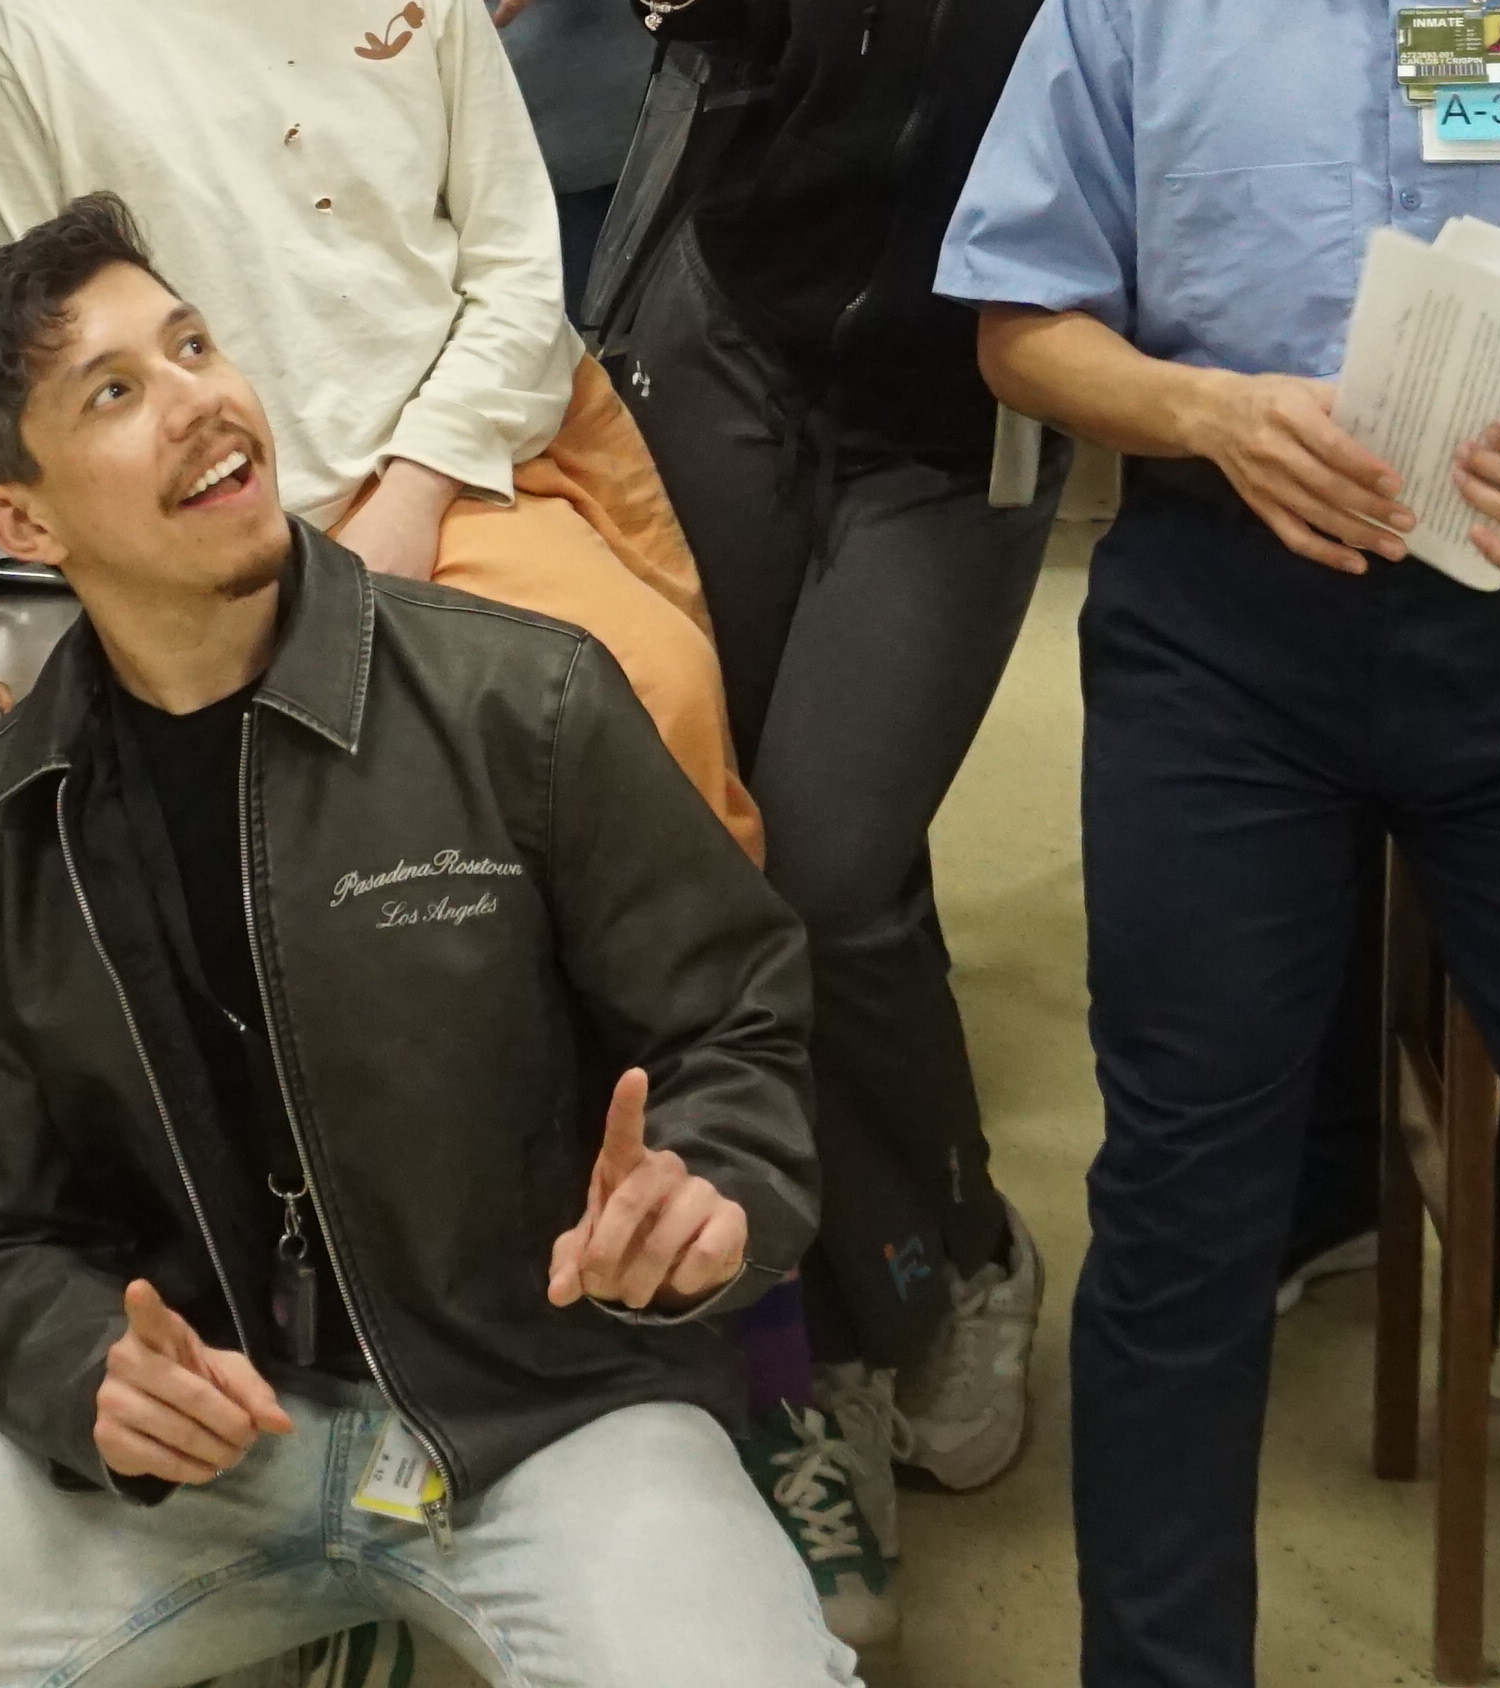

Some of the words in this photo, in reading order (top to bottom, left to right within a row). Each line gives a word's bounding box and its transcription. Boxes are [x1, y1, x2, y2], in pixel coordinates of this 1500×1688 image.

[1412, 17, 1465, 28] INMATE
[329, 859, 432, 908] Pasadena
[375, 900, 419, 930] Los
[422, 892, 499, 927] Angeles
